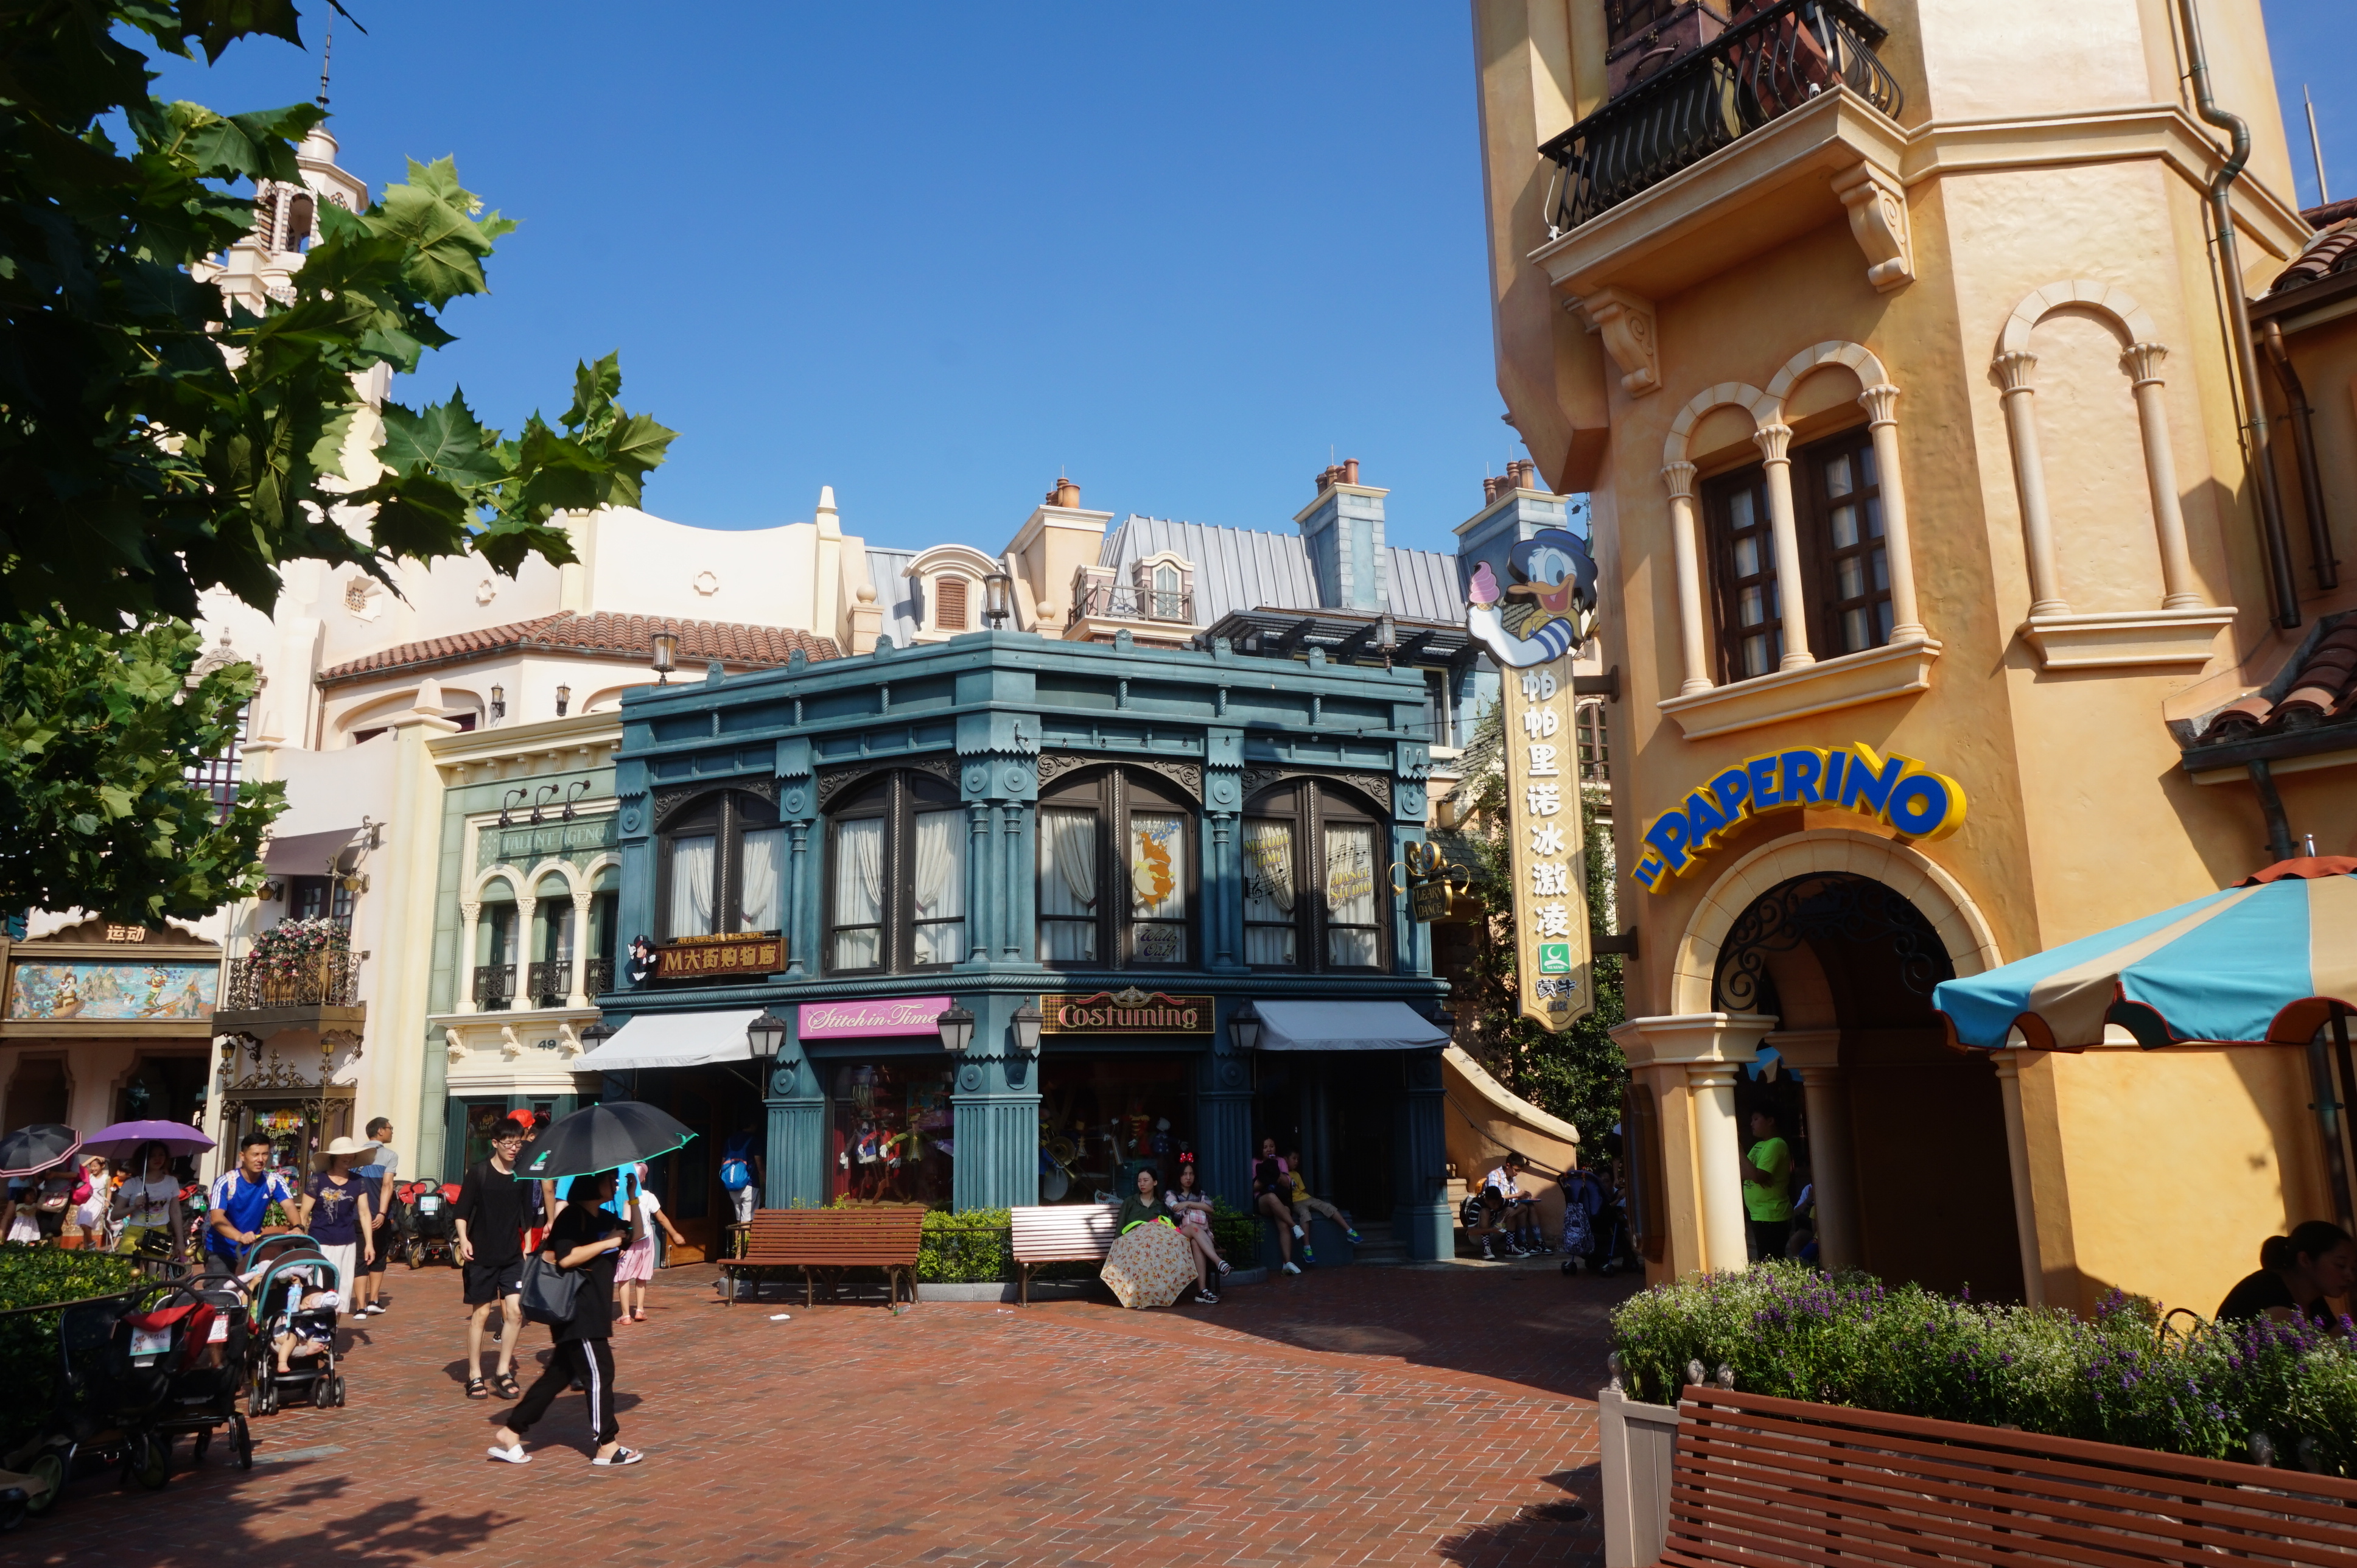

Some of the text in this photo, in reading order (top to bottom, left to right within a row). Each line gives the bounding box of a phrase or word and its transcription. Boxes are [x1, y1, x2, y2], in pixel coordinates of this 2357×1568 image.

[1521, 670, 1570, 937] 帕帕里诺冰激凌
[1631, 743, 1963, 894] IL PAPERINO
[503, 825, 613, 851] TALENT AGENCY
[1244, 833, 1291, 856] MELODY
[1253, 850, 1283, 869] TIME
[1331, 866, 1371, 887] DANCE
[1329, 880, 1372, 904] STUDIO
[1416, 886, 1443, 901] LEARN
[1418, 902, 1443, 918] DANCE
[106, 925, 146, 942] 运动
[677, 934, 715, 945] AVENUE
[725, 931, 765, 941] ARCADE
[1140, 928, 1178, 948] Waltz
[664, 945, 776, 972] M大街购物廊
[1143, 943, 1176, 957] Out!
[1536, 978, 1577, 998] 蒙牛
[808, 1004, 939, 1033] Stitch in Time
[1058, 1004, 1198, 1029] Costuming
[537, 1039, 556, 1051] 49
